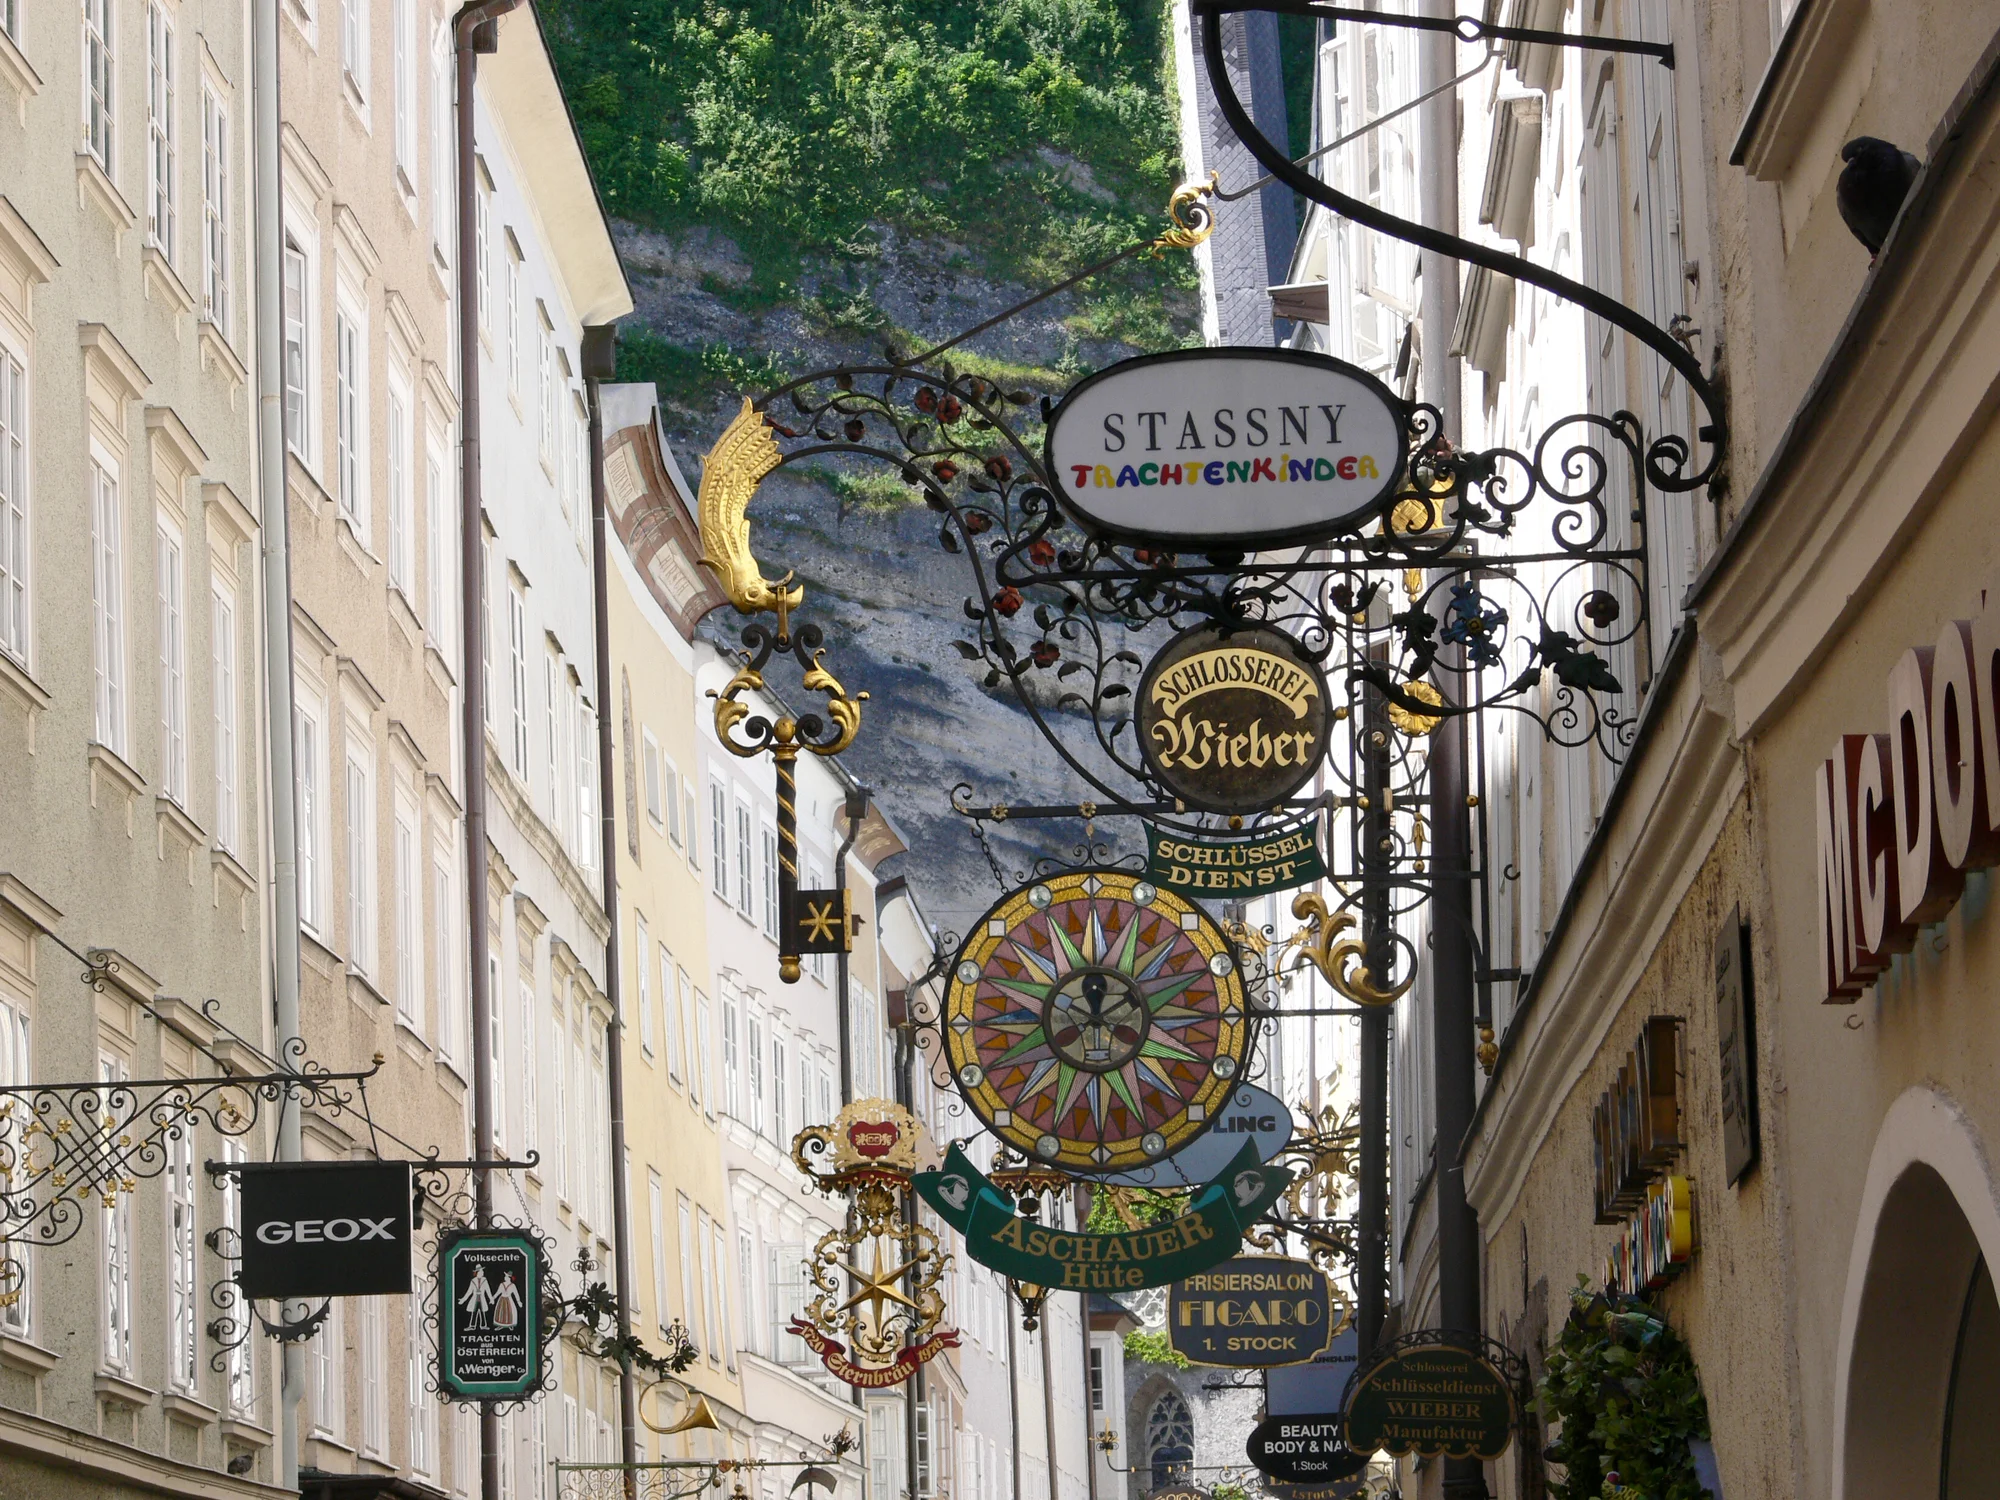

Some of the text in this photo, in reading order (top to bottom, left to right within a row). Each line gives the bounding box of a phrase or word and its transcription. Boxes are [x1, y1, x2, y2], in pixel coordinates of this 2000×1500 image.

[1103, 404, 1346, 452] STASSNY
[660, 556, 689, 595] HIRSCH
[1158, 654, 1310, 705] SCHLOSSEREI
[1151, 711, 1316, 770] Wieber
[1157, 832, 1313, 867] SCHLÜSSEL
[1168, 860, 1296, 889] DIENST
[256, 1217, 397, 1245] GEOX
[991, 1212, 1214, 1262] ASCHAUER
[464, 1253, 520, 1262] Volksechte
[1060, 1262, 1144, 1288] Hüte
[1185, 1273, 1313, 1292] FRISIERSALON
[1178, 1299, 1321, 1327] FIGARO
[461, 1335, 520, 1343] TRACHTEN
[1203, 1337, 1297, 1350] 1. STOCK
[457, 1347, 525, 1356] ÖSTERREICH
[800, 1325, 944, 1387] 1720 Sternbräu 1976
[1402, 1361, 1469, 1373] Schlosserei
[1370, 1377, 1498, 1396] Schlüsseldienst
[1386, 1401, 1482, 1418] WIEBER
[1281, 1425, 1338, 1438] BEAUTY
[1382, 1423, 1488, 1441] Manufaktur
[1264, 1441, 1306, 1454] BODY
[1309, 1440, 1319, 1453] &
[1291, 1460, 1328, 1471] 1.Stock
